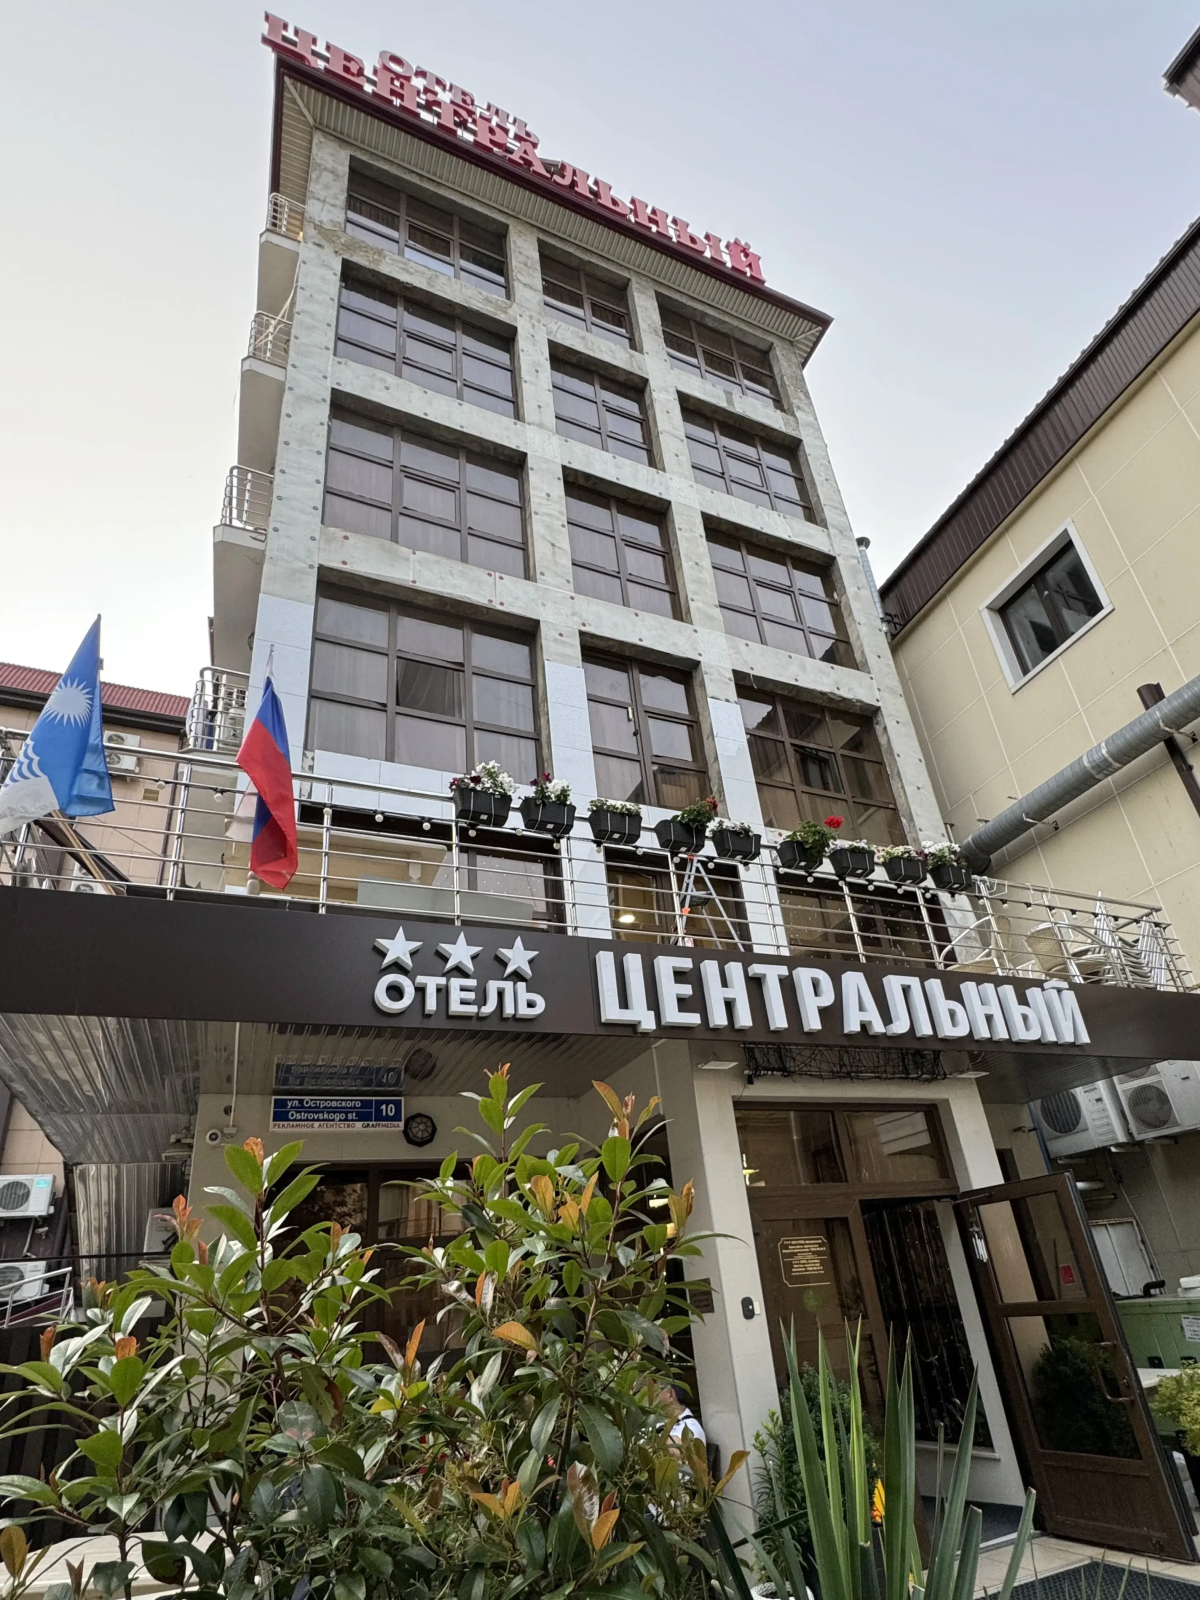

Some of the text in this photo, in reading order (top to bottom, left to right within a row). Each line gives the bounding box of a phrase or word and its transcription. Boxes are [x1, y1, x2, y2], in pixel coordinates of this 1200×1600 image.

[378, 50, 540, 151] ОТЕЛЬ
[261, 10, 767, 287] ЦЕНТРАЛЬНЫЙ
[374, 973, 546, 1019] ОТЕЛЬ
[595, 950, 1091, 1045] ЦЕНТРАЛЬНЫЙ
[287, 1098, 361, 1109] ул. Островского
[288, 1111, 359, 1121] Ostrovskogo st.
[380, 1104, 395, 1116] 10
